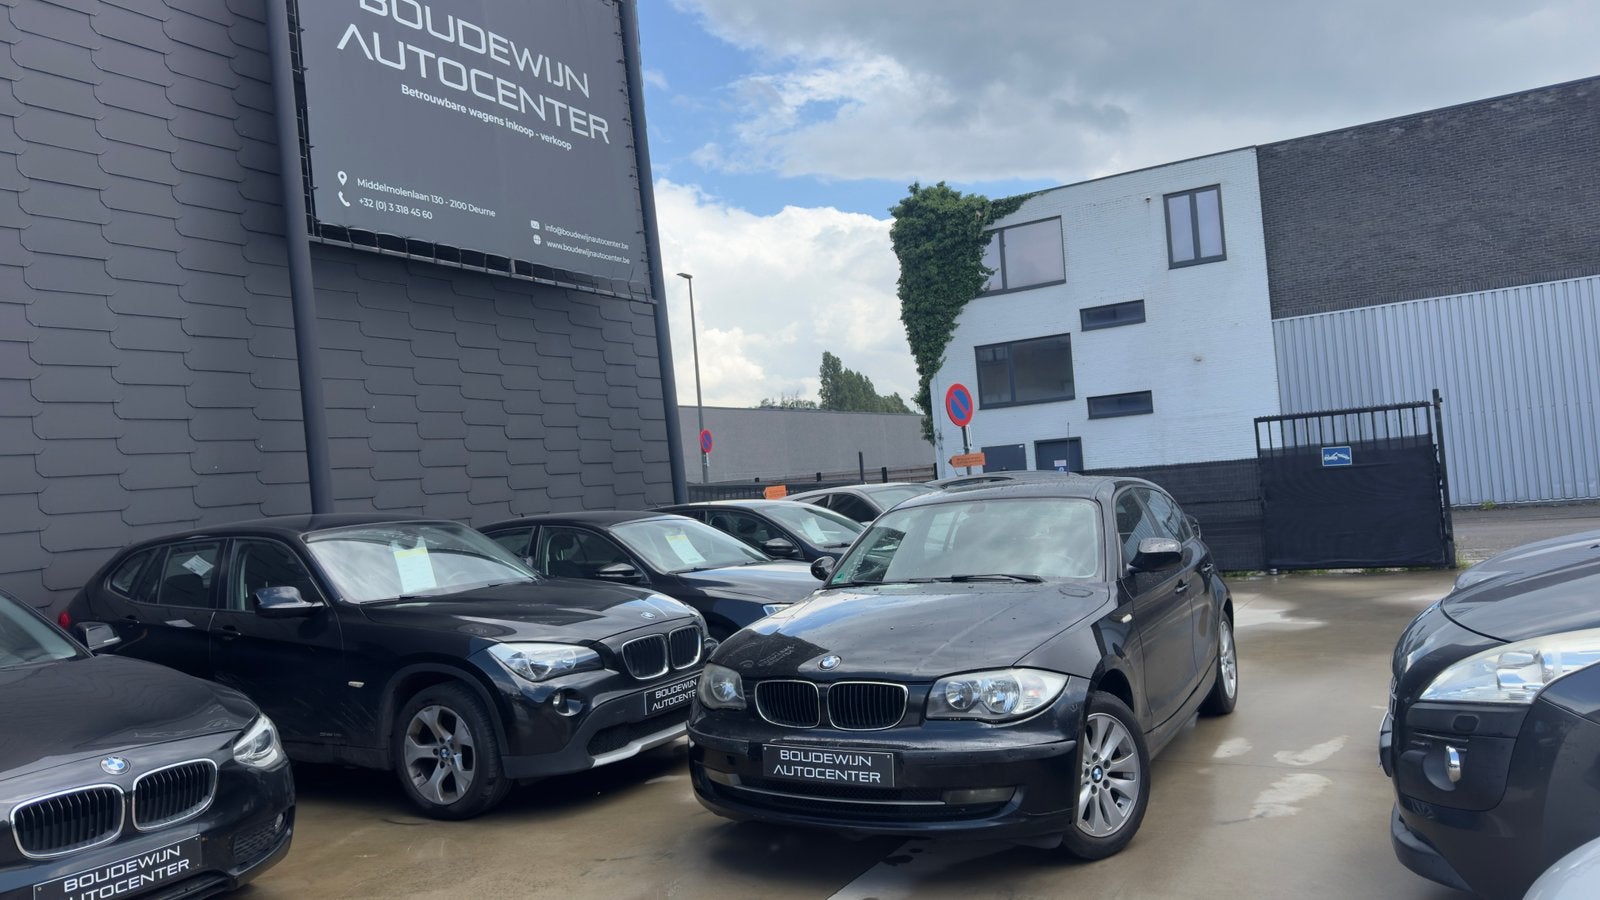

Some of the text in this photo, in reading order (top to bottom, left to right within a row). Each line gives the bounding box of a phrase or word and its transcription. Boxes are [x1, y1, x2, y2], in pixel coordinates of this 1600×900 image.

[337, 23, 610, 144] AUTOCENTER
[401, 83, 467, 114] Betrouwbare
[468, 106, 505, 127] wagens
[505, 117, 534, 139] inkoop
[540, 132, 572, 151] verkoop
[357, 177, 430, 202] Middelmolenlaan
[430, 194, 444, 205] 130
[449, 199, 468, 211] 2100
[468, 203, 496, 217] Deurne
[359, 197, 433, 220] +32 (0) 3 318 45 60
[544, 223, 629, 250] info@boudewijnautocenter.be
[546, 240, 630, 265] www.boudewijnautocenter.be
[652, 689, 696, 711] AUTOCENTE
[655, 678, 697, 699] BOUDEWIJN
[780, 749, 872, 767] BOUDEWIJN
[773, 764, 881, 783] AUTOCENTER
[64, 845, 181, 893] BOUDEWIJN
[69, 858, 190, 900] TOCENTER
